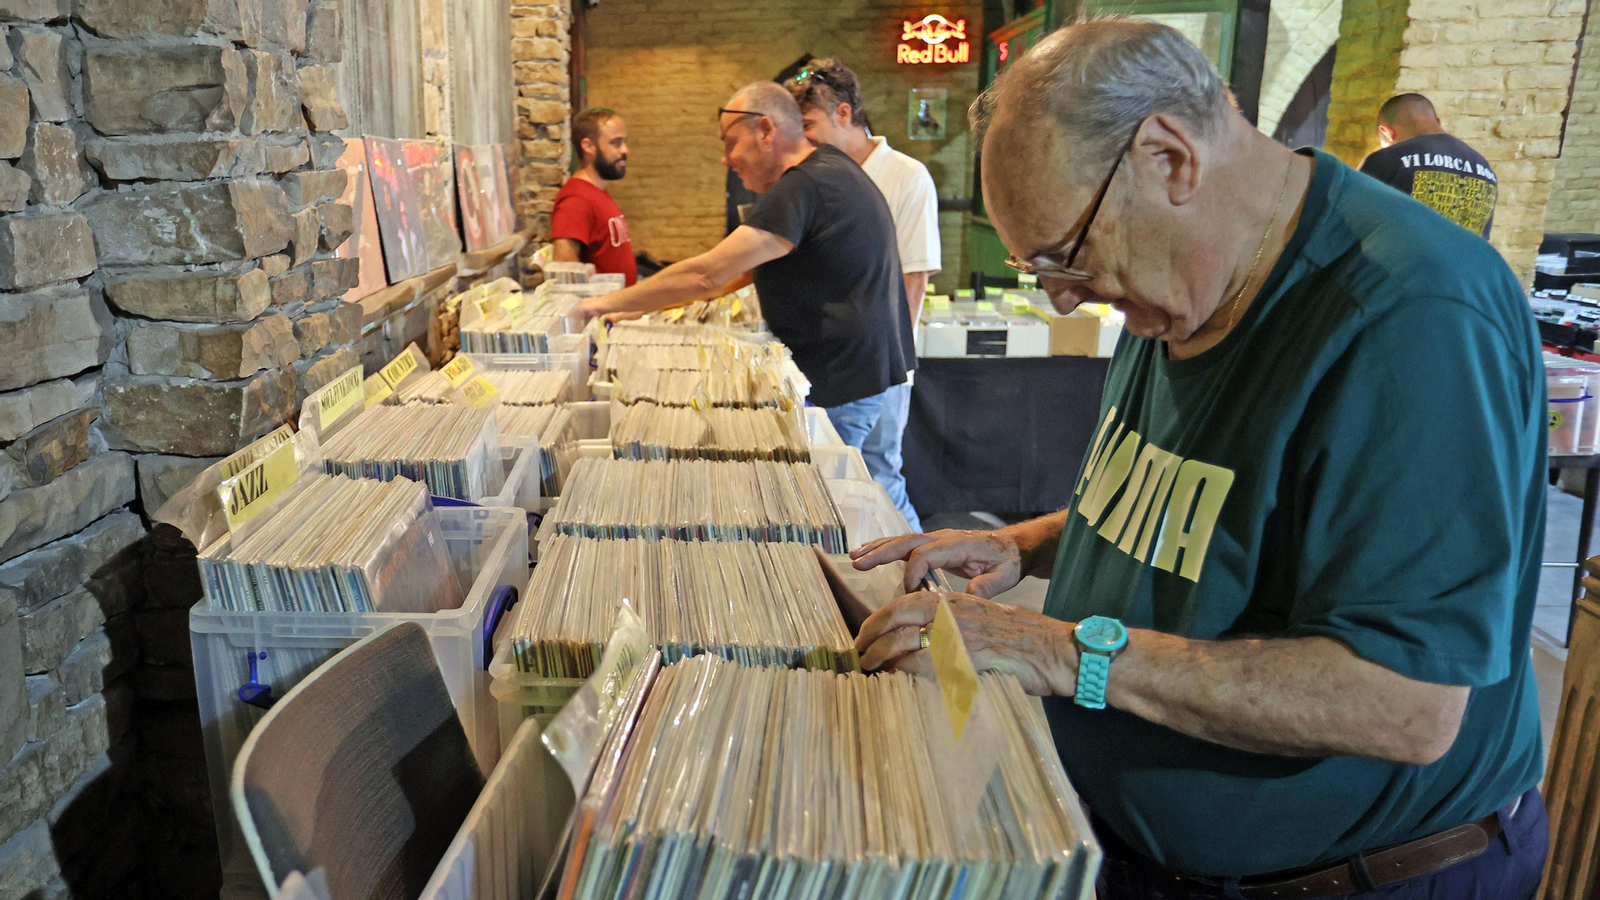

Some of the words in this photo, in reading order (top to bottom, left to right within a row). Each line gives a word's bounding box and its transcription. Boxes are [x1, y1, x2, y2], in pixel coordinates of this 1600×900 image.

[896, 43, 933, 64] Red
[934, 41, 970, 64] Bull
[1424, 153, 1473, 173] LORCA
[387, 352, 414, 383] COUNTRY
[231, 463, 269, 516] JAZZ
